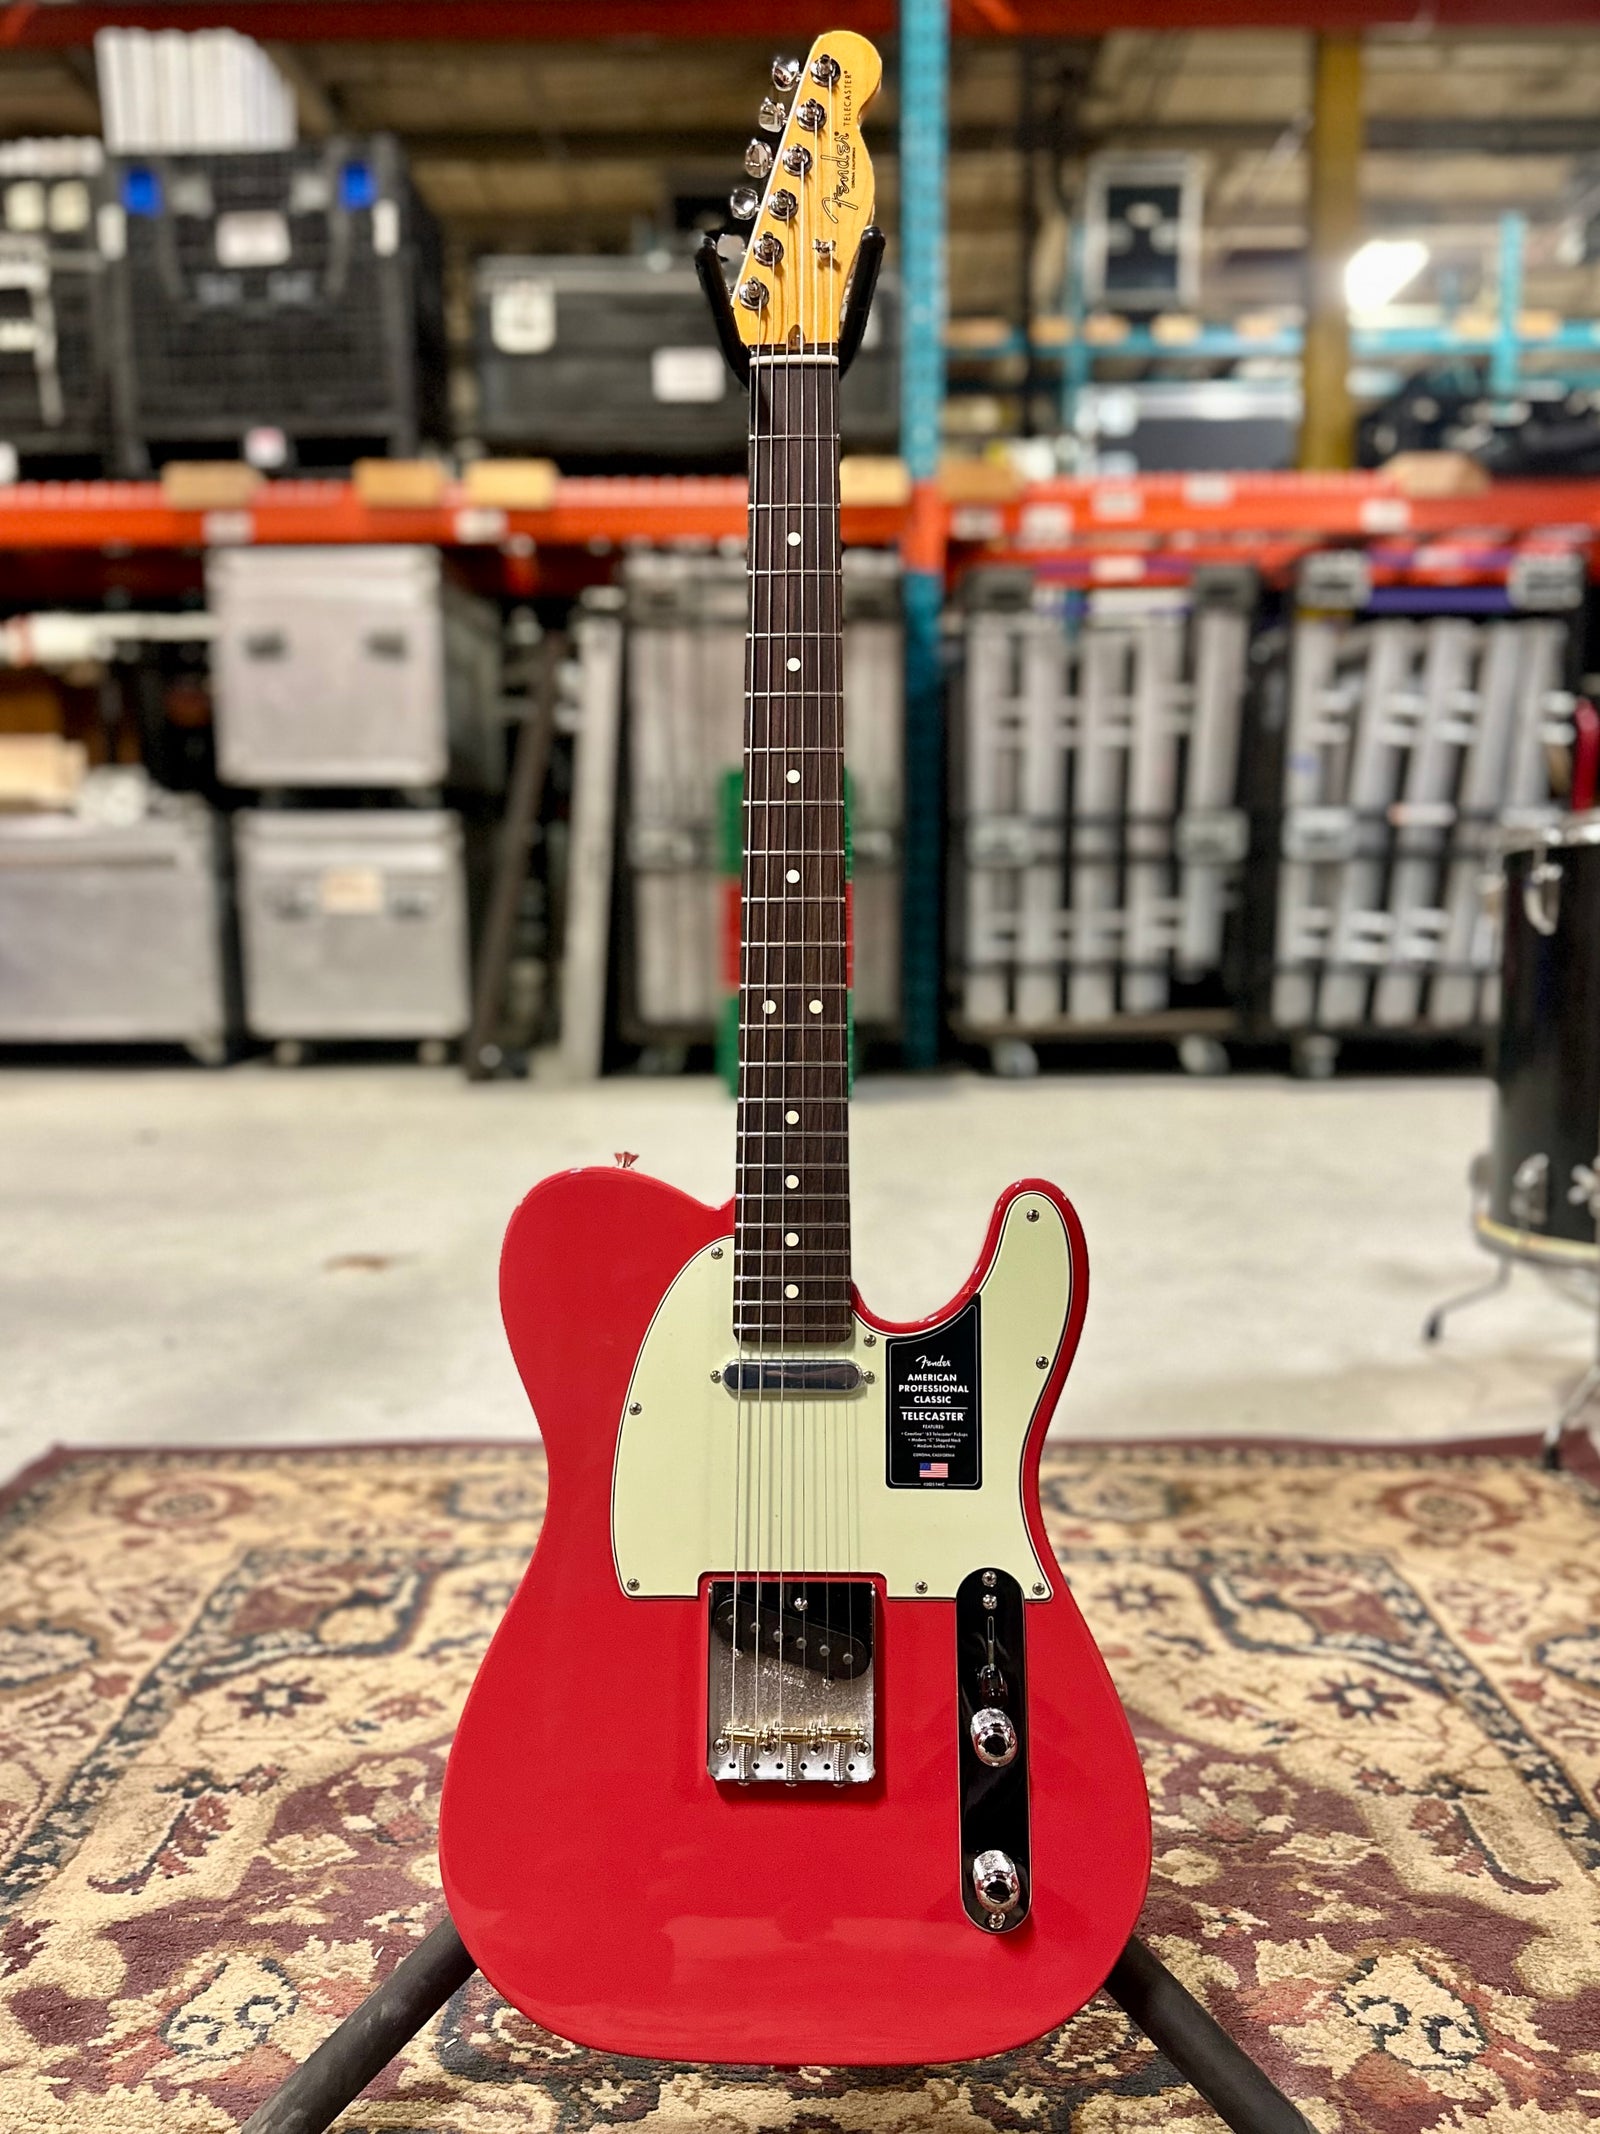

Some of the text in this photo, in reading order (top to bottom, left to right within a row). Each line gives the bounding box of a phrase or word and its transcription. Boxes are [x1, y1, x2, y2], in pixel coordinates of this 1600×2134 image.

[843, 71, 852, 126] TELECASTER
[820, 132, 859, 224] Fender
[915, 1355, 951, 1369] Fender
[907, 1374, 957, 1382] AMERICAN
[898, 1384, 969, 1393] PROFESSIONAL
[913, 1395, 952, 1404] CLASSIC
[901, 1411, 965, 1421] TELECASTER
